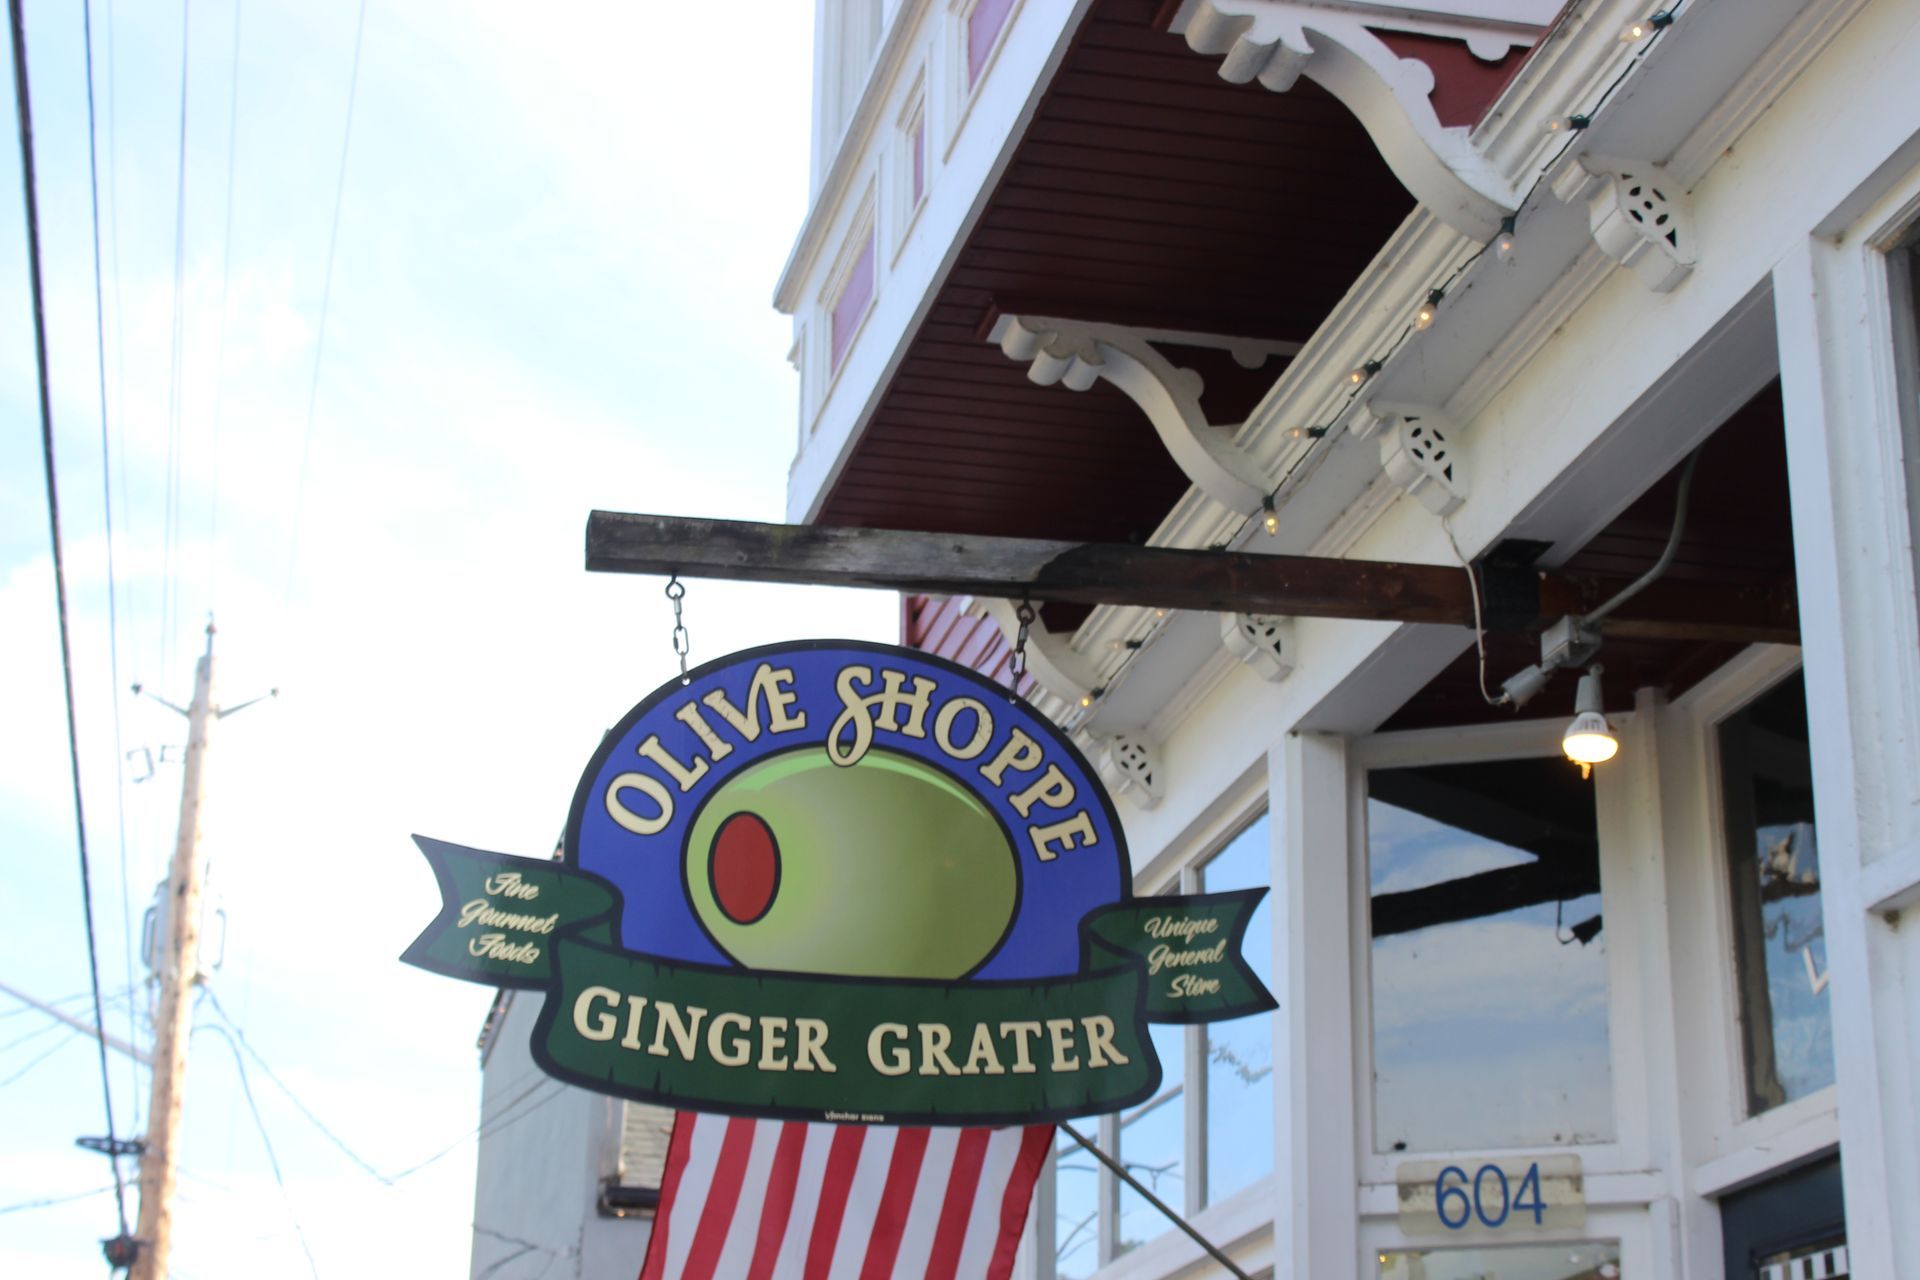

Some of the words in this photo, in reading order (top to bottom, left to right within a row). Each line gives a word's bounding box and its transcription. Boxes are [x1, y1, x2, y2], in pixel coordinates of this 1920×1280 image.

[605, 663, 807, 836] OLIVE
[826, 664, 1099, 862] SHOPPE
[485, 872, 539, 900] Fine
[457, 898, 559, 934] Gourmet
[1144, 915, 1219, 945] Unique
[468, 933, 541, 964] Foods
[1147, 938, 1227, 976] General
[1166, 973, 1221, 998] Store
[572, 985, 837, 1075] GINGER
[866, 1014, 1129, 1077] GRATER
[1435, 1162, 1548, 1230] 604
